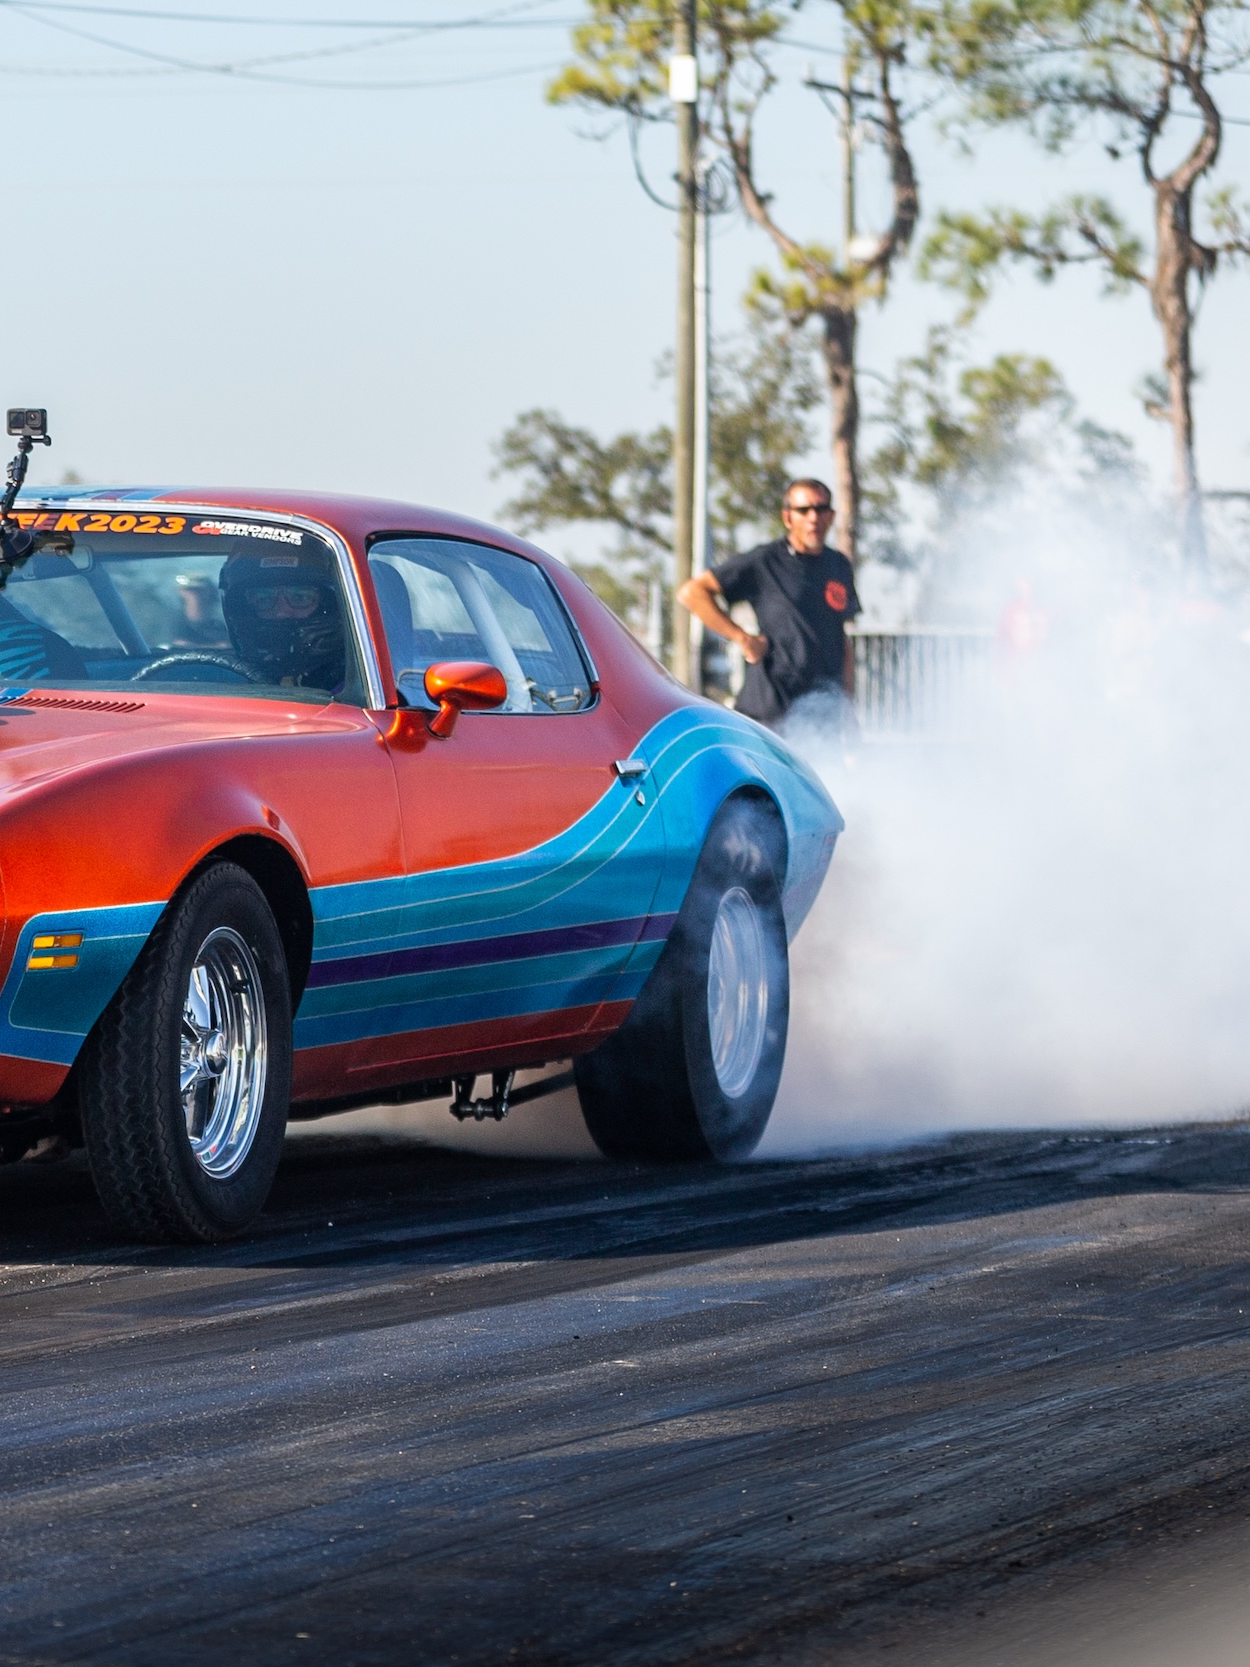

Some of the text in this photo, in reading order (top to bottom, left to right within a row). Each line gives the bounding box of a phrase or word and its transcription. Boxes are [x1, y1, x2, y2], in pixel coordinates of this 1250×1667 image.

[200, 521, 304, 539] OVERDRIVE
[220, 529, 249, 537] GEAR
[251, 531, 303, 546] VENDORS
